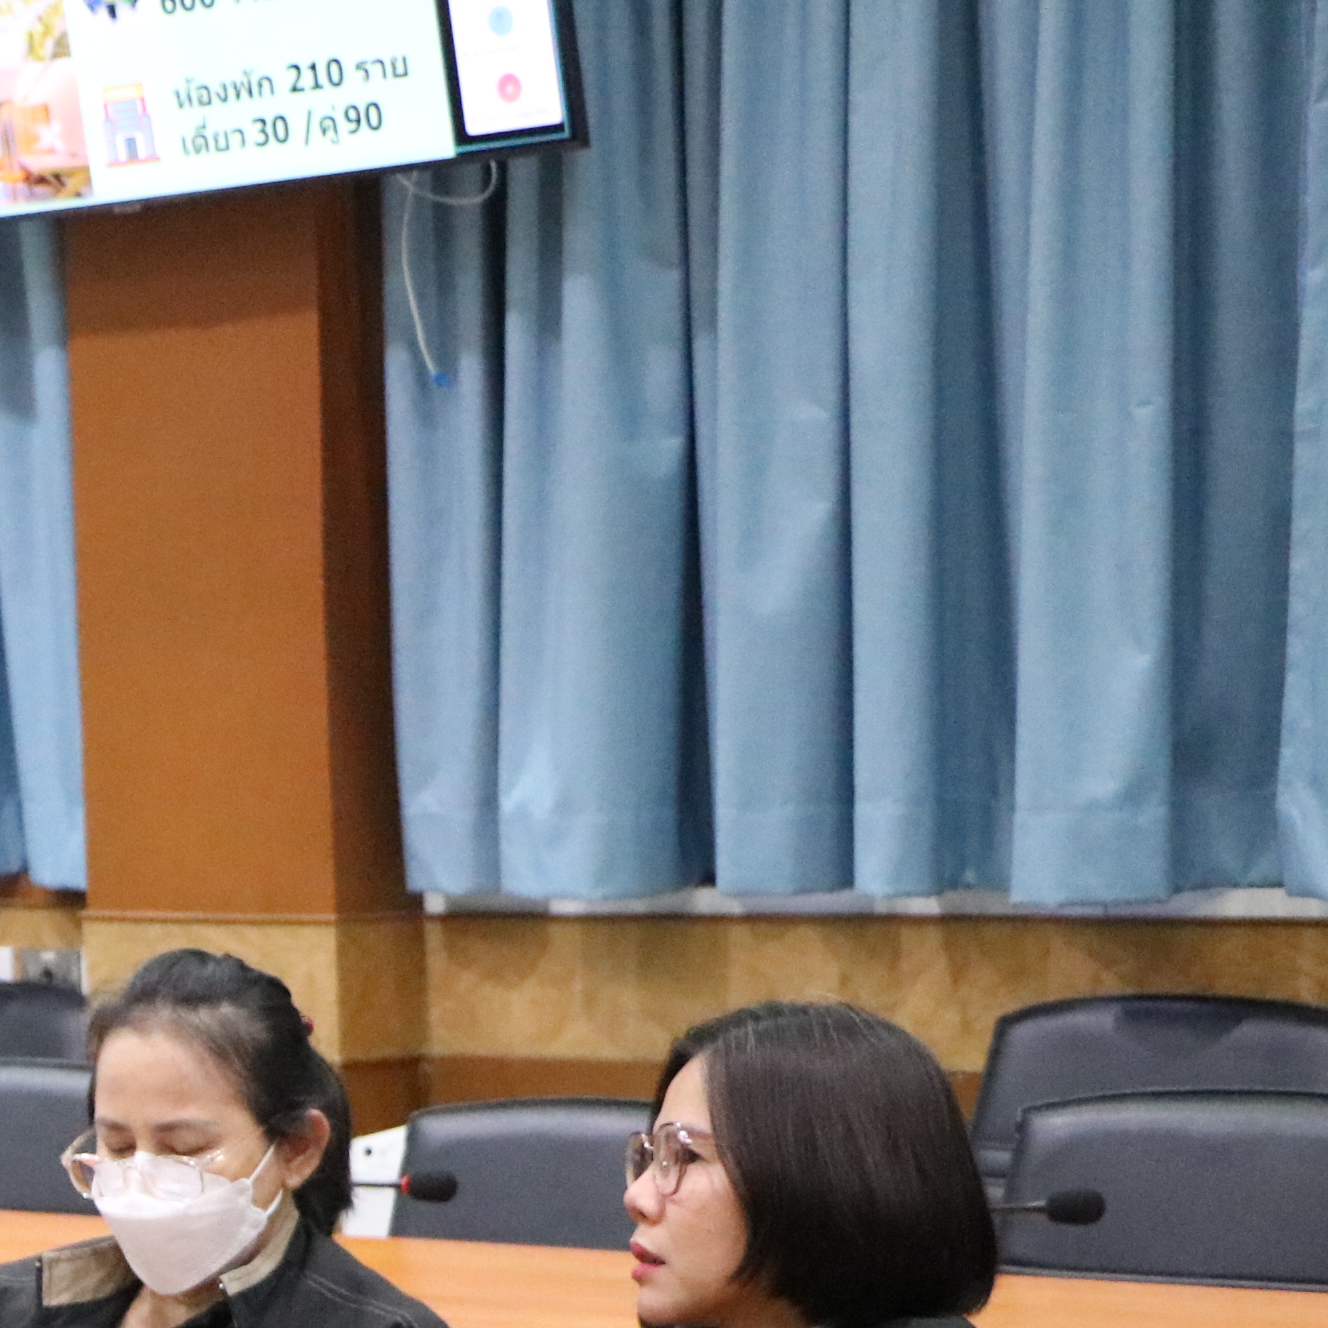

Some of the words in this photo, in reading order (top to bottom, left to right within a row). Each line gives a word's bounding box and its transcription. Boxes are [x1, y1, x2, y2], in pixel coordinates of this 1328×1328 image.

[173, 68, 275, 110] ห้องพัก
[286, 58, 345, 94] 210
[354, 55, 410, 83] ราย
